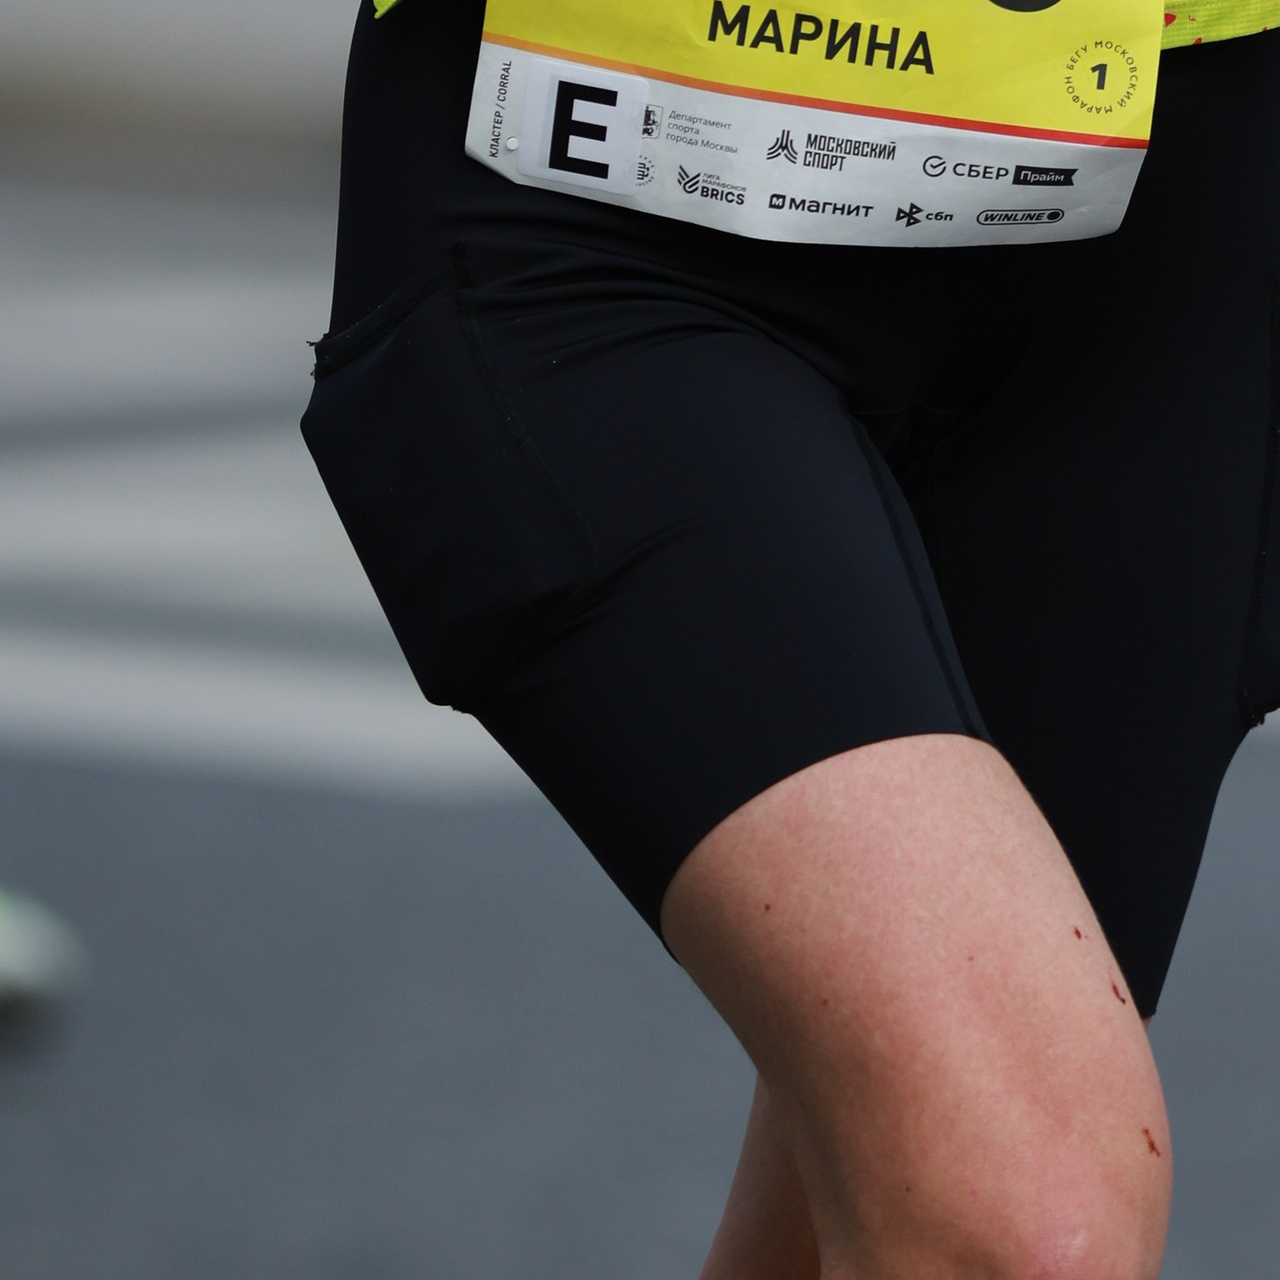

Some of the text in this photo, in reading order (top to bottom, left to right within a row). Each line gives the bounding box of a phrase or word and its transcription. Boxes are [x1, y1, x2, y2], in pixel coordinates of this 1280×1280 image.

[708, 0, 936, 75] МАРИНА
[496, 60, 512, 103] CORRAL
[1064, 40, 1139, 114] БЕГУ МОСКОВСКИЙ МАРАФОН
[1090, 63, 1108, 91] 1
[667, 122, 700, 135] спорта
[668, 110, 732, 130] Департамент
[489, 110, 504, 159] КЛАСТЕР
[665, 132, 738, 154] города Москвы
[805, 133, 897, 161] МОСКОВСКИЙ
[803, 151, 846, 171] СПОРТ
[702, 172, 721, 181] ЛИГА
[952, 162, 1065, 183] СБЕР Прайм
[700, 186, 746, 206] BRICS
[701, 179, 747, 192] МАРАФОНОВ
[788, 197, 874, 218] магнит
[925, 211, 954, 222] сбп
[982, 212, 1047, 223] WINLINE
